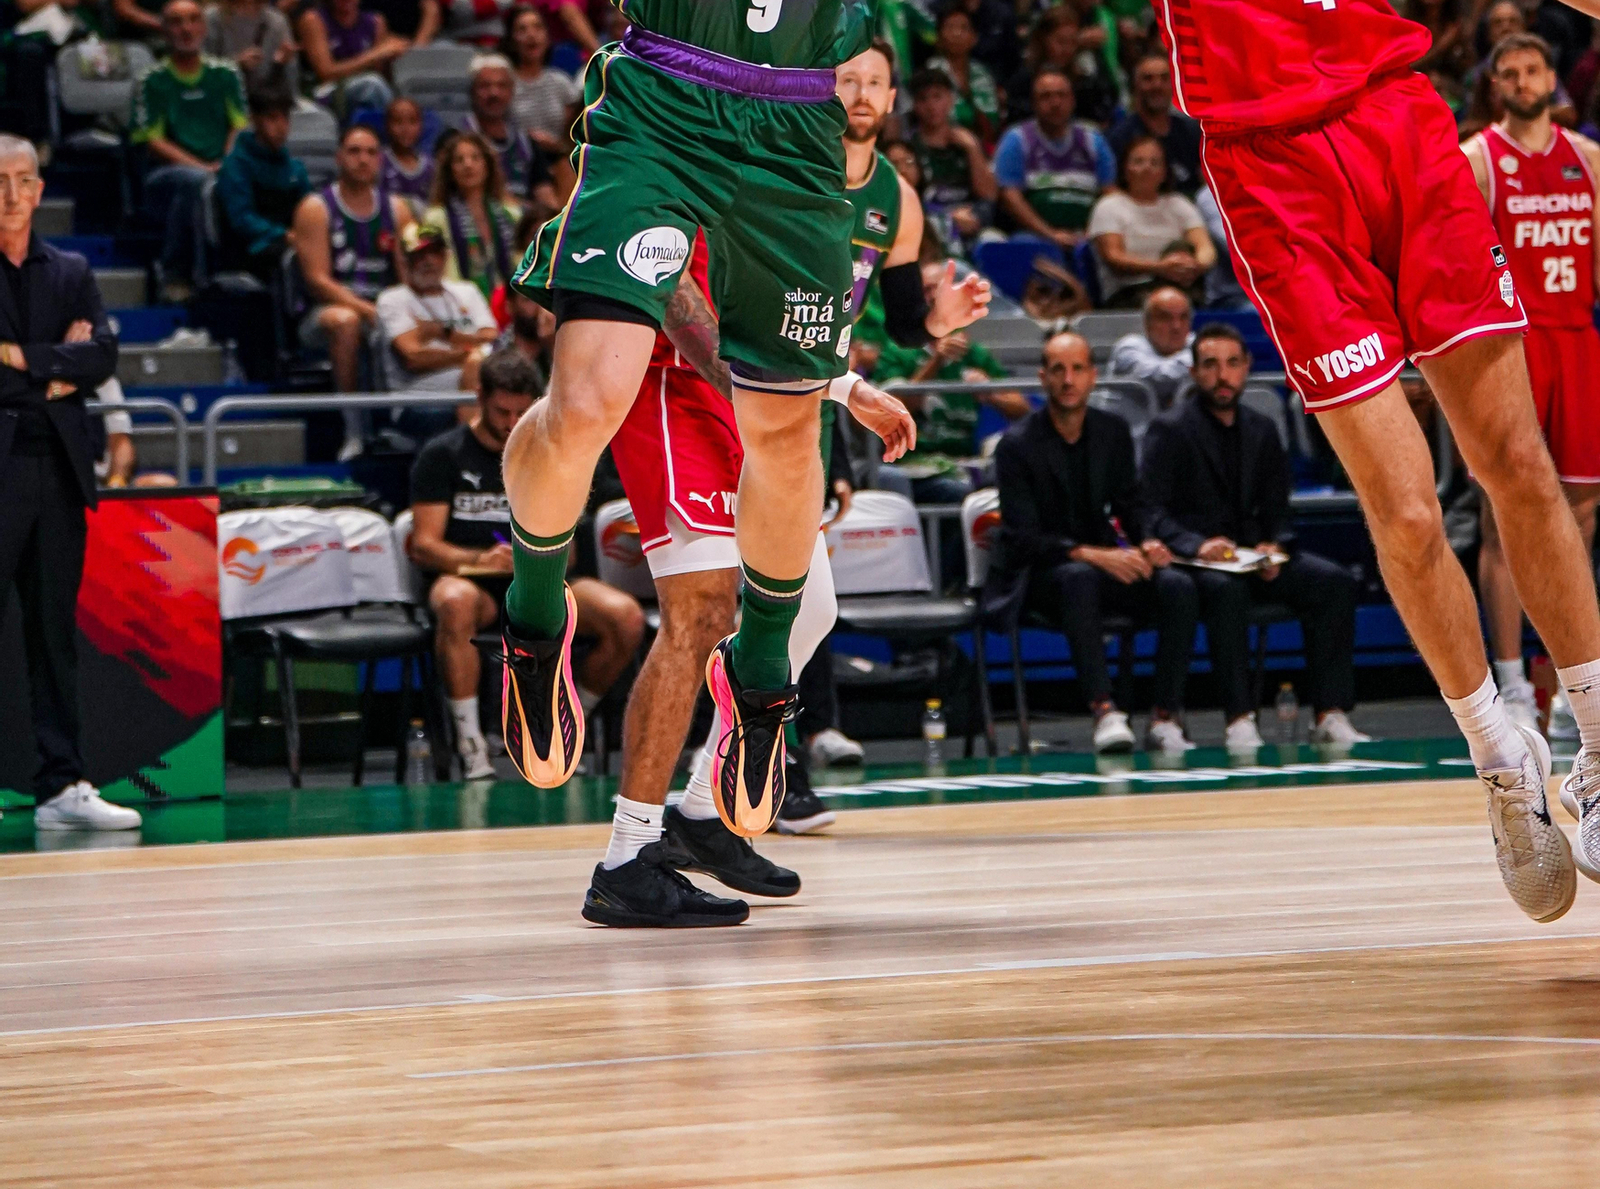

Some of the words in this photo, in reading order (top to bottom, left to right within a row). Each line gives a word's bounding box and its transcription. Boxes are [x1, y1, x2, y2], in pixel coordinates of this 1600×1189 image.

[1506, 192, 1594, 214] GIRONA
[1514, 217, 1592, 248] FIATC
[1542, 256, 1577, 293] 25
[784, 287, 822, 303] sabor
[793, 296, 835, 324] má
[779, 312, 831, 349] laga
[1313, 332, 1386, 383] YOSOY
